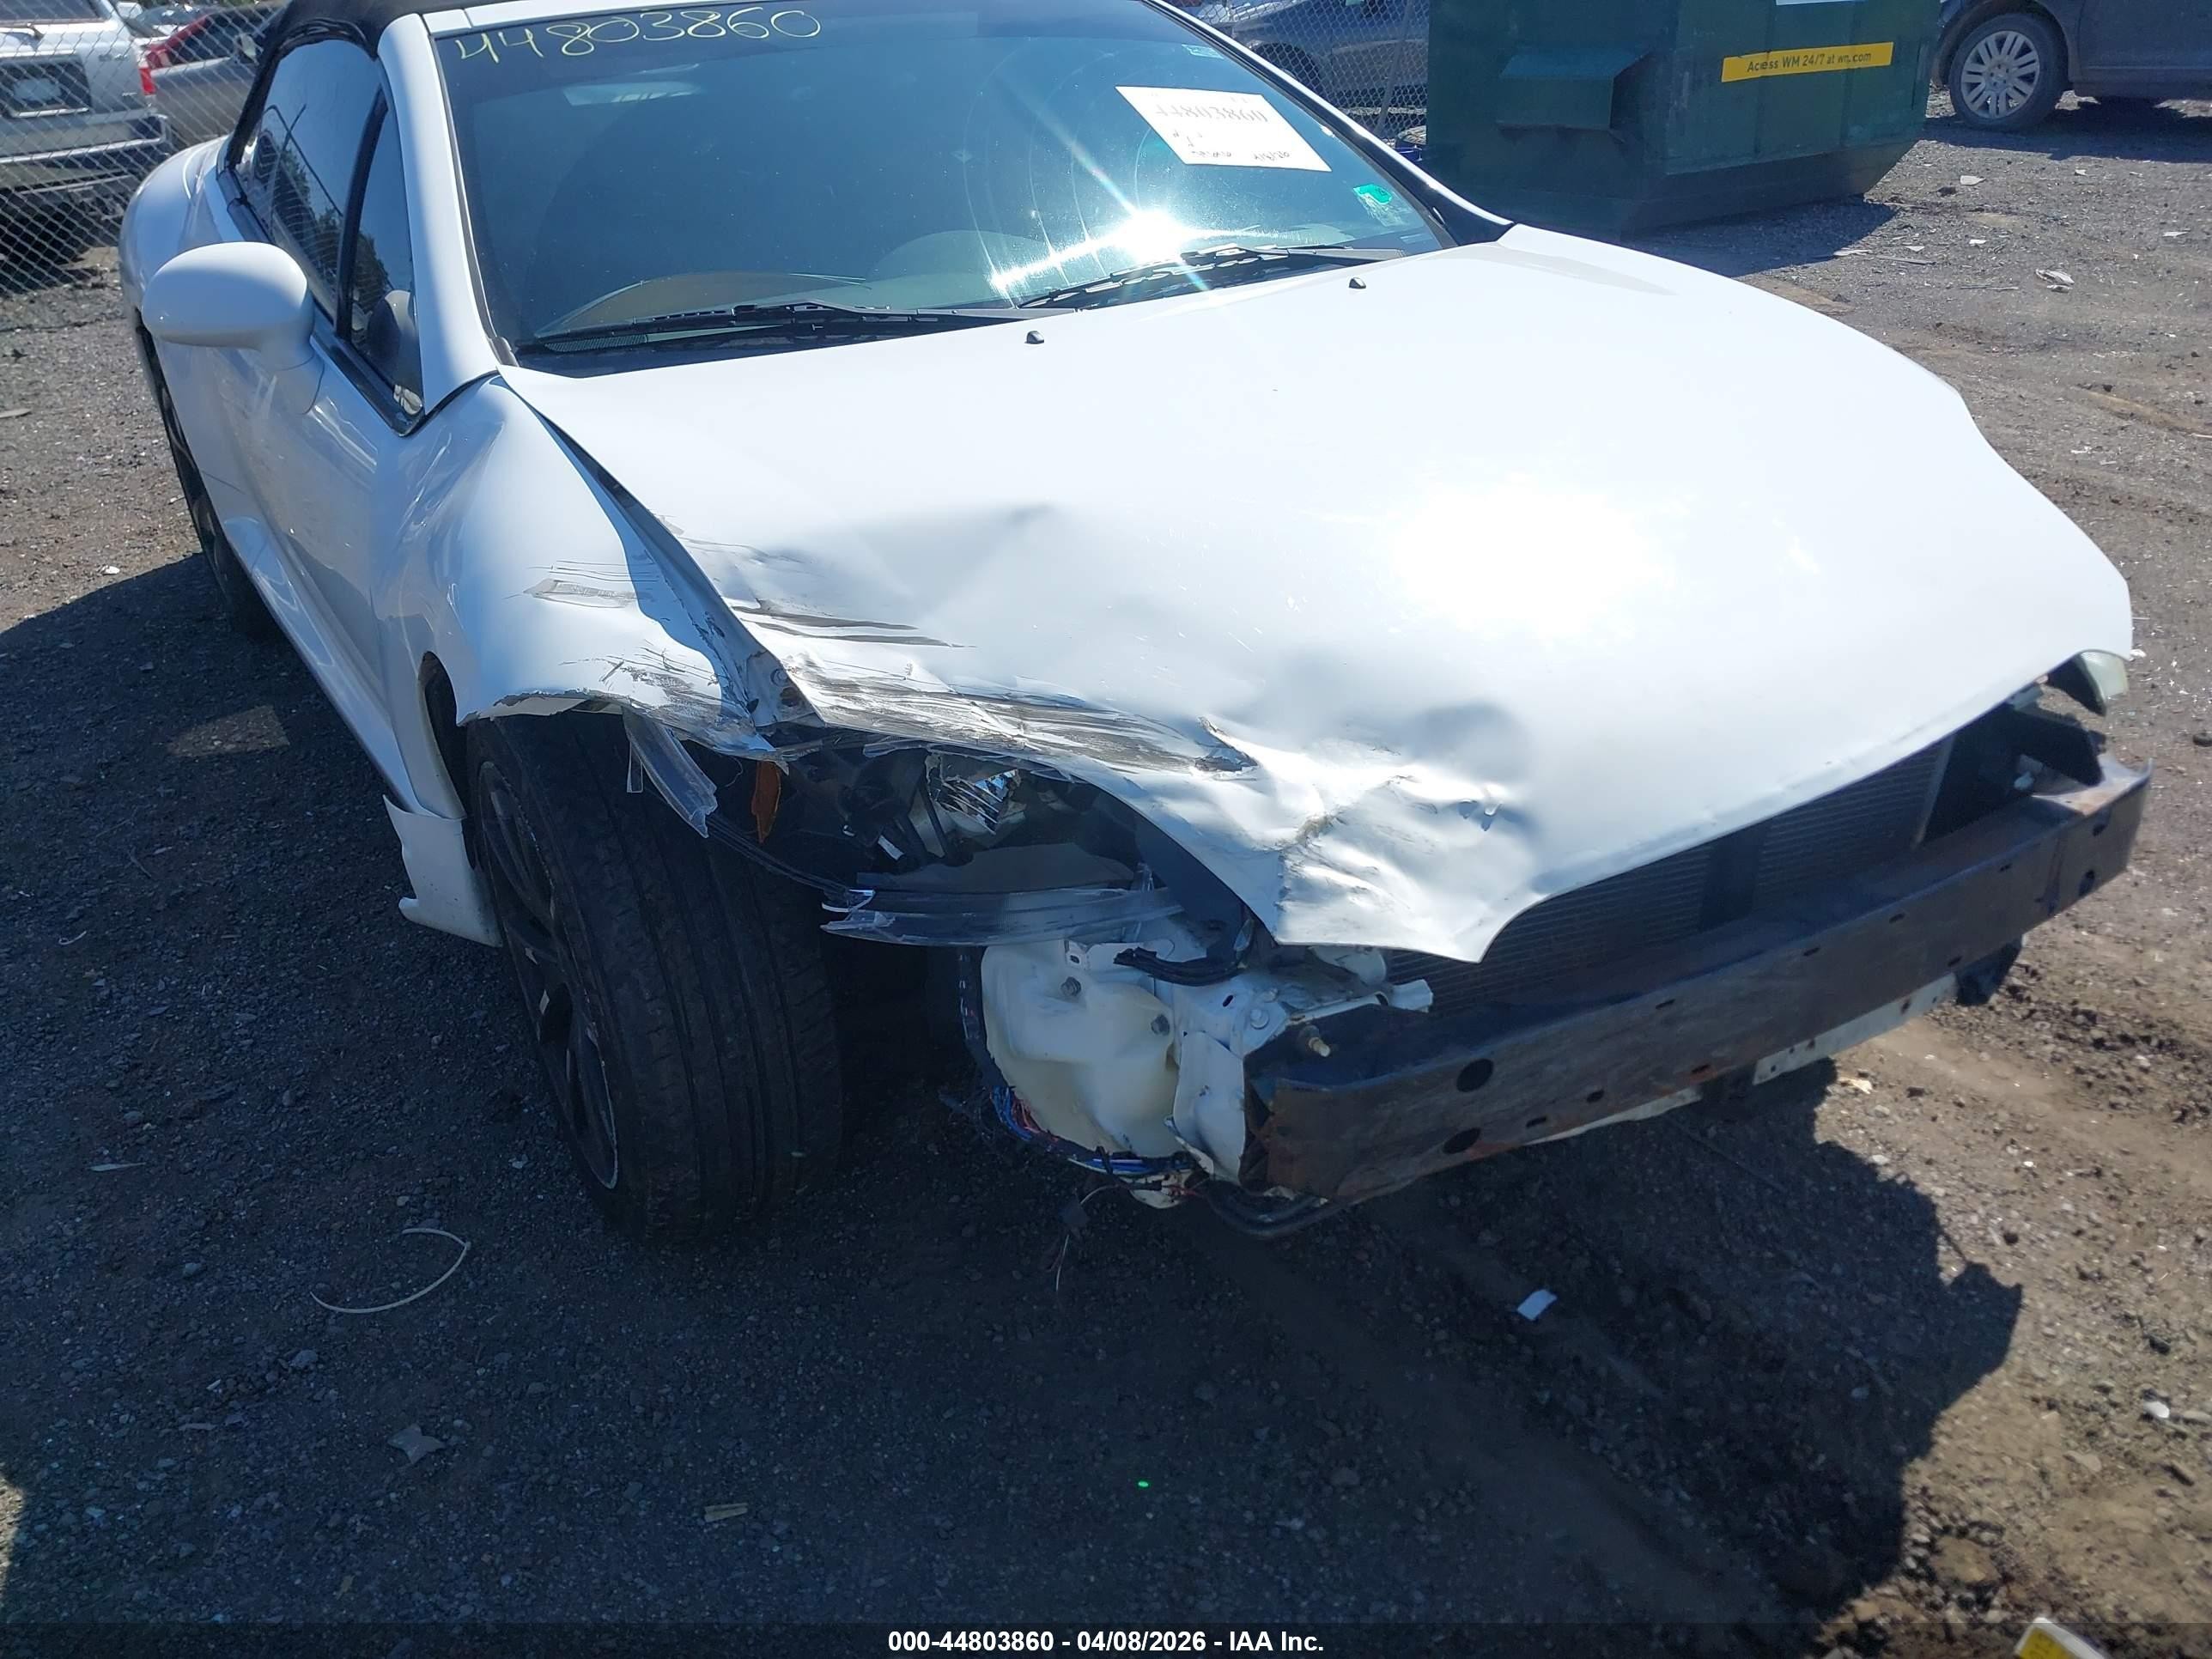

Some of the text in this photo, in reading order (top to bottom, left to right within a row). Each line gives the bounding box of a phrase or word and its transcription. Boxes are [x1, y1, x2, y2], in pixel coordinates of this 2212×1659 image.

[455, 7, 820, 64] 44803860
[1782, 55, 1801, 68] WM
[1802, 52, 1826, 66] 24/7
[1826, 54, 1835, 64] at
